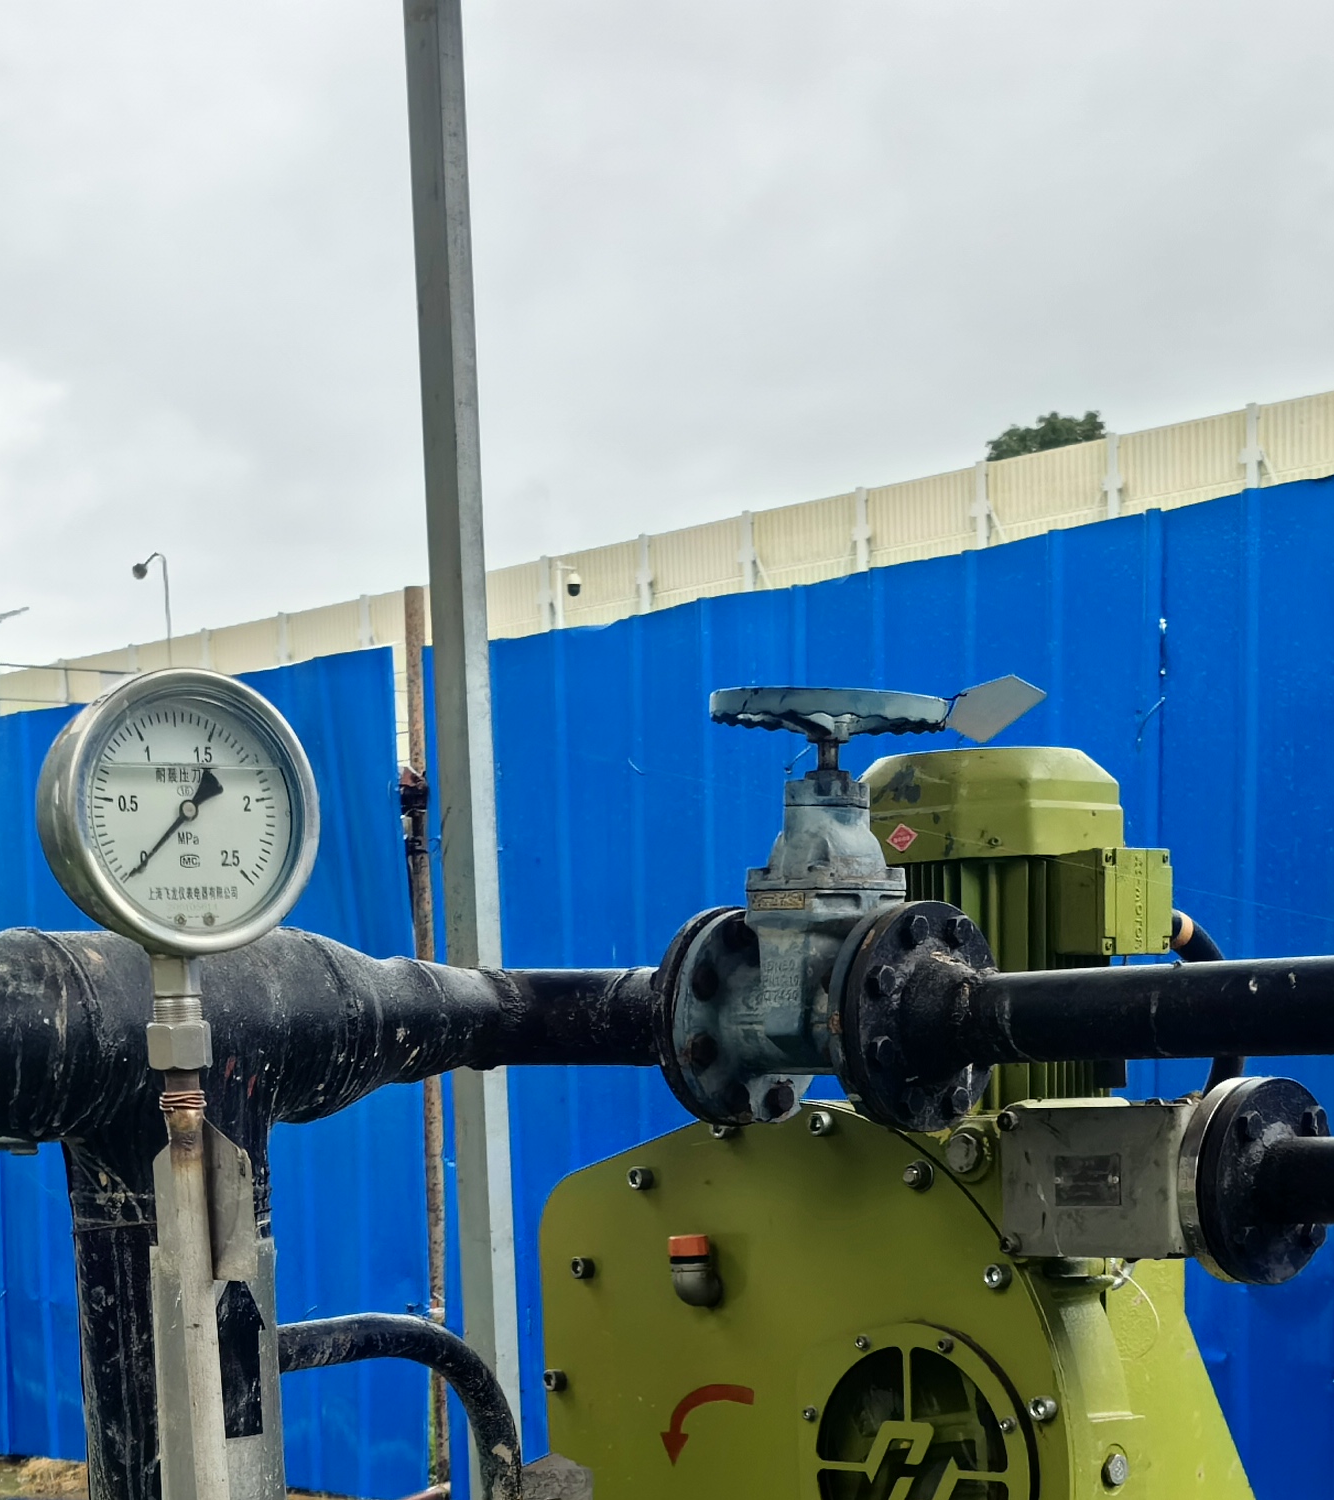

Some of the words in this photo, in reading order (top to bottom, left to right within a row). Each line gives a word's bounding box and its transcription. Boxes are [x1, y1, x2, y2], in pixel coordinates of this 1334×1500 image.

[144, 746, 151, 762] 1
[194, 746, 213, 763] 1.5
[118, 796, 138, 812] 0.5
[243, 796, 252, 812] 2
[177, 831, 199, 845] MPa
[221, 850, 240, 867] 2.5
